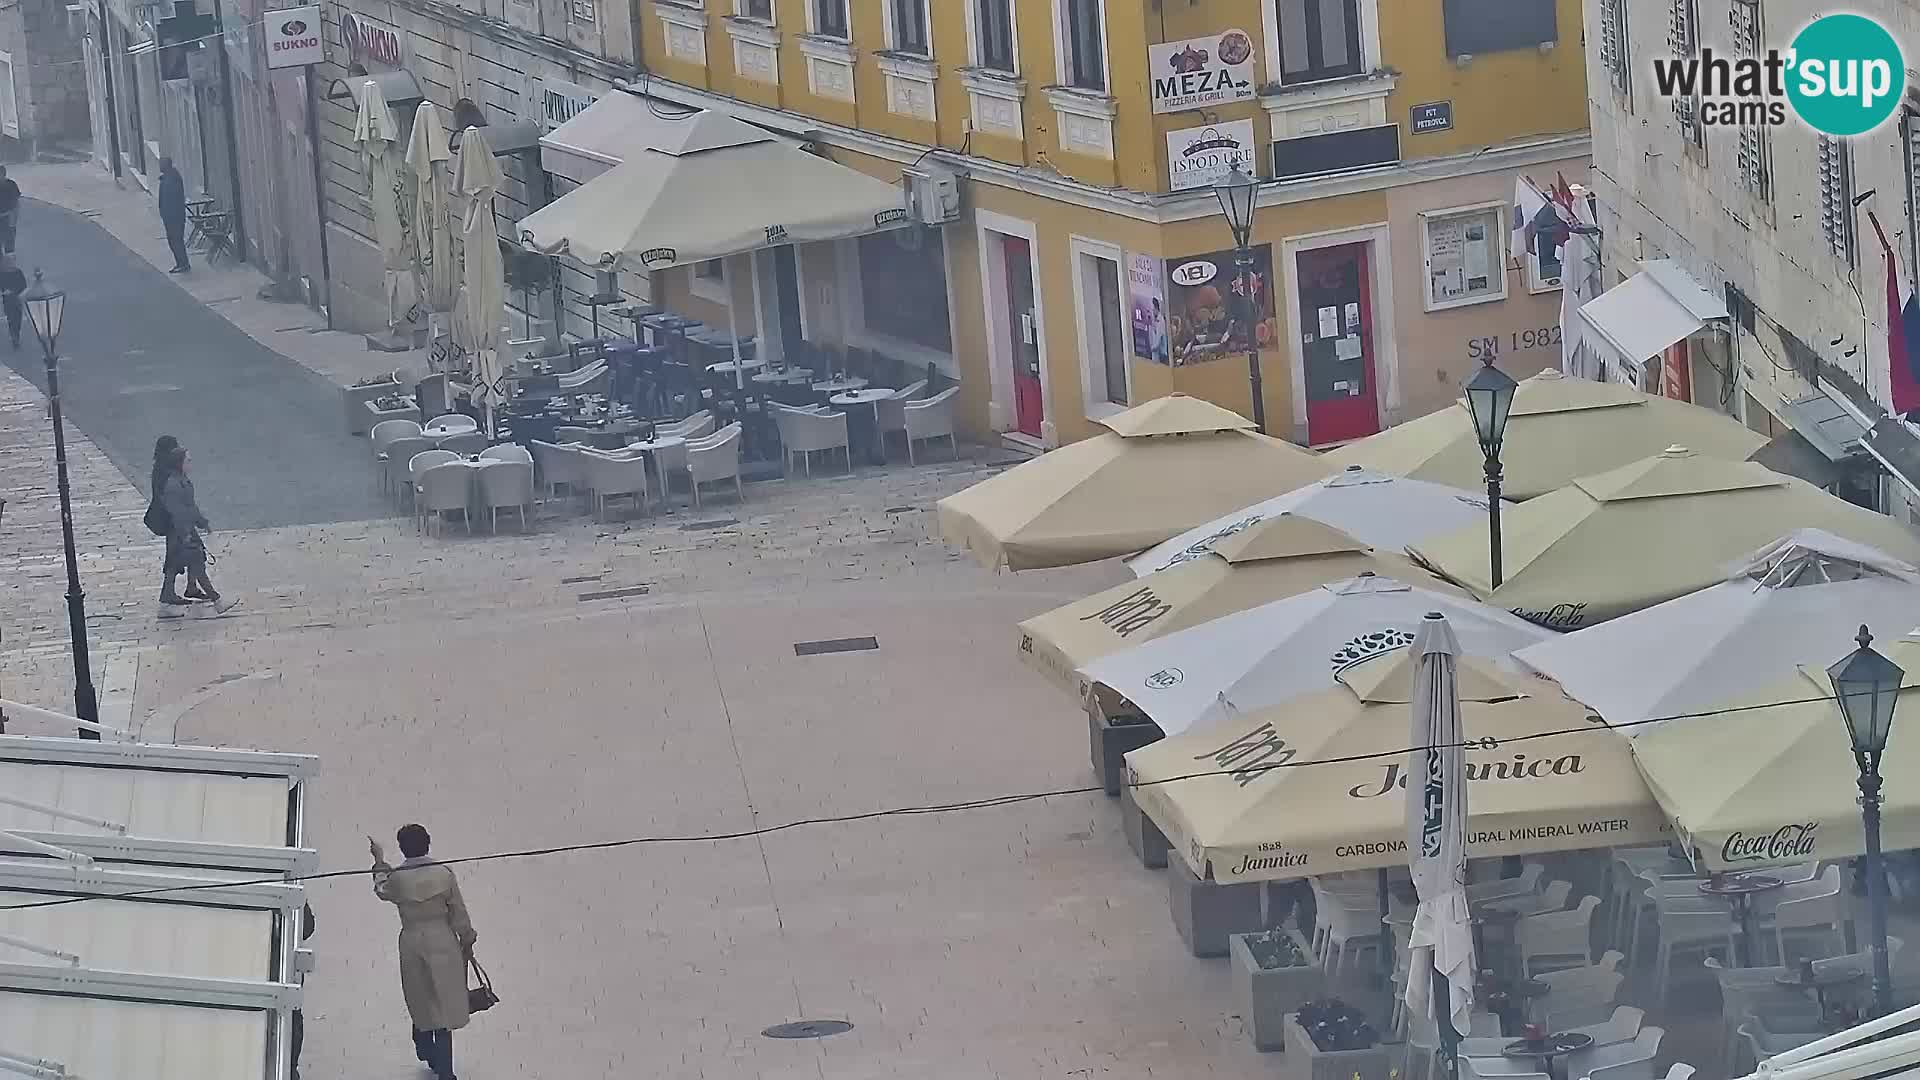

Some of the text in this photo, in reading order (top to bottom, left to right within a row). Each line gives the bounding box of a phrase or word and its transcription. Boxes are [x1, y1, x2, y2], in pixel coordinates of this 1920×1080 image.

[274, 38, 318, 52] SUKNO
[360, 22, 399, 62] SUKNO
[1155, 69, 1234, 99] MEZA
[1164, 95, 1197, 108] PIZZERIA
[1204, 91, 1225, 101] GRILL
[1174, 154, 1219, 173] ISPOD
[1467, 325, 1562, 358] SM 1982
[1509, 824, 1574, 841] MINERAL
[1577, 819, 1629, 833] WATER
[1257, 841, 1282, 852] 1828
[1231, 851, 1308, 875] Jamnica
